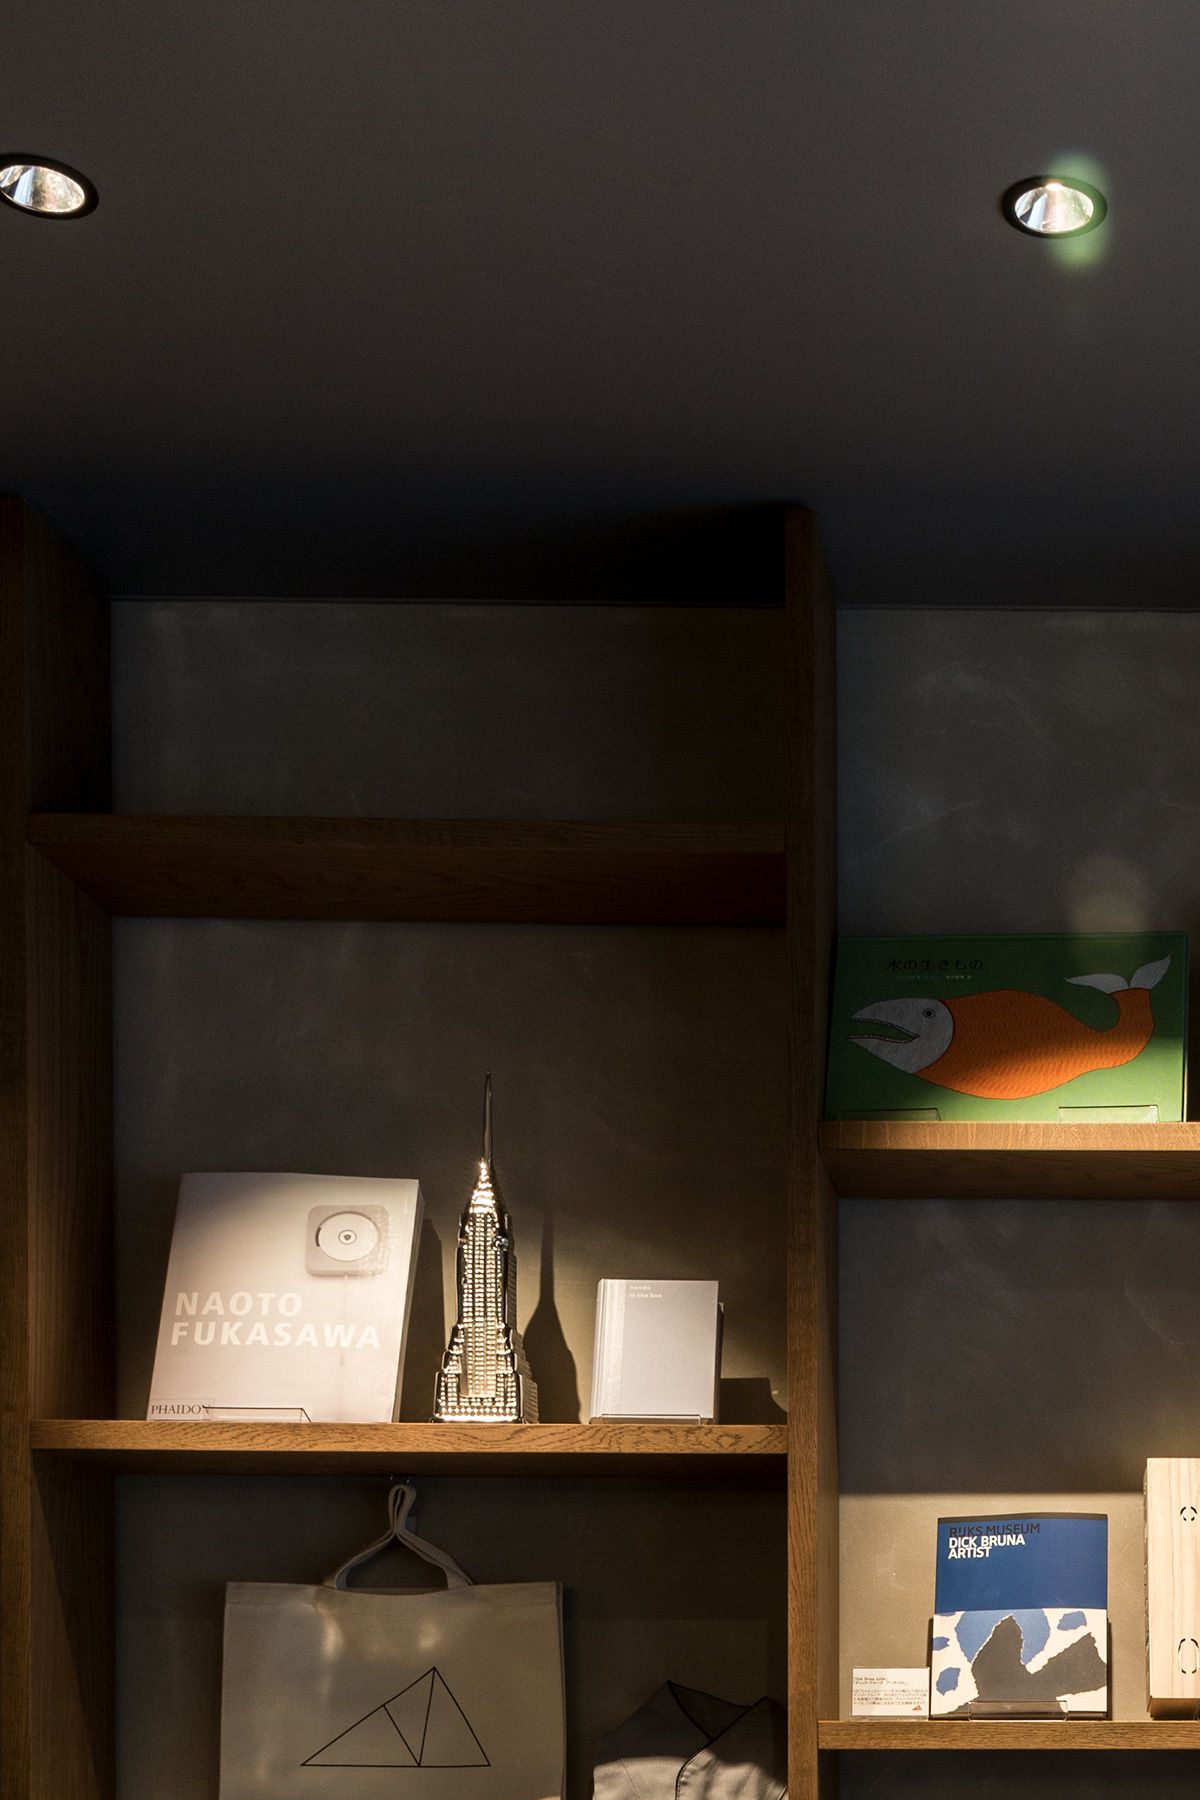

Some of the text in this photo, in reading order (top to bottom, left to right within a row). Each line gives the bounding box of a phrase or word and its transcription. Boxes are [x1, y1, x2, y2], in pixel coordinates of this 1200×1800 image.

[175, 1292, 303, 1317] NAOTO
[171, 1321, 381, 1349] FUKASAWA
[985, 1523, 1041, 1535] MUSEUM
[948, 1534, 1026, 1548] DICK BRUNA
[947, 1546, 992, 1560] ARTIST
